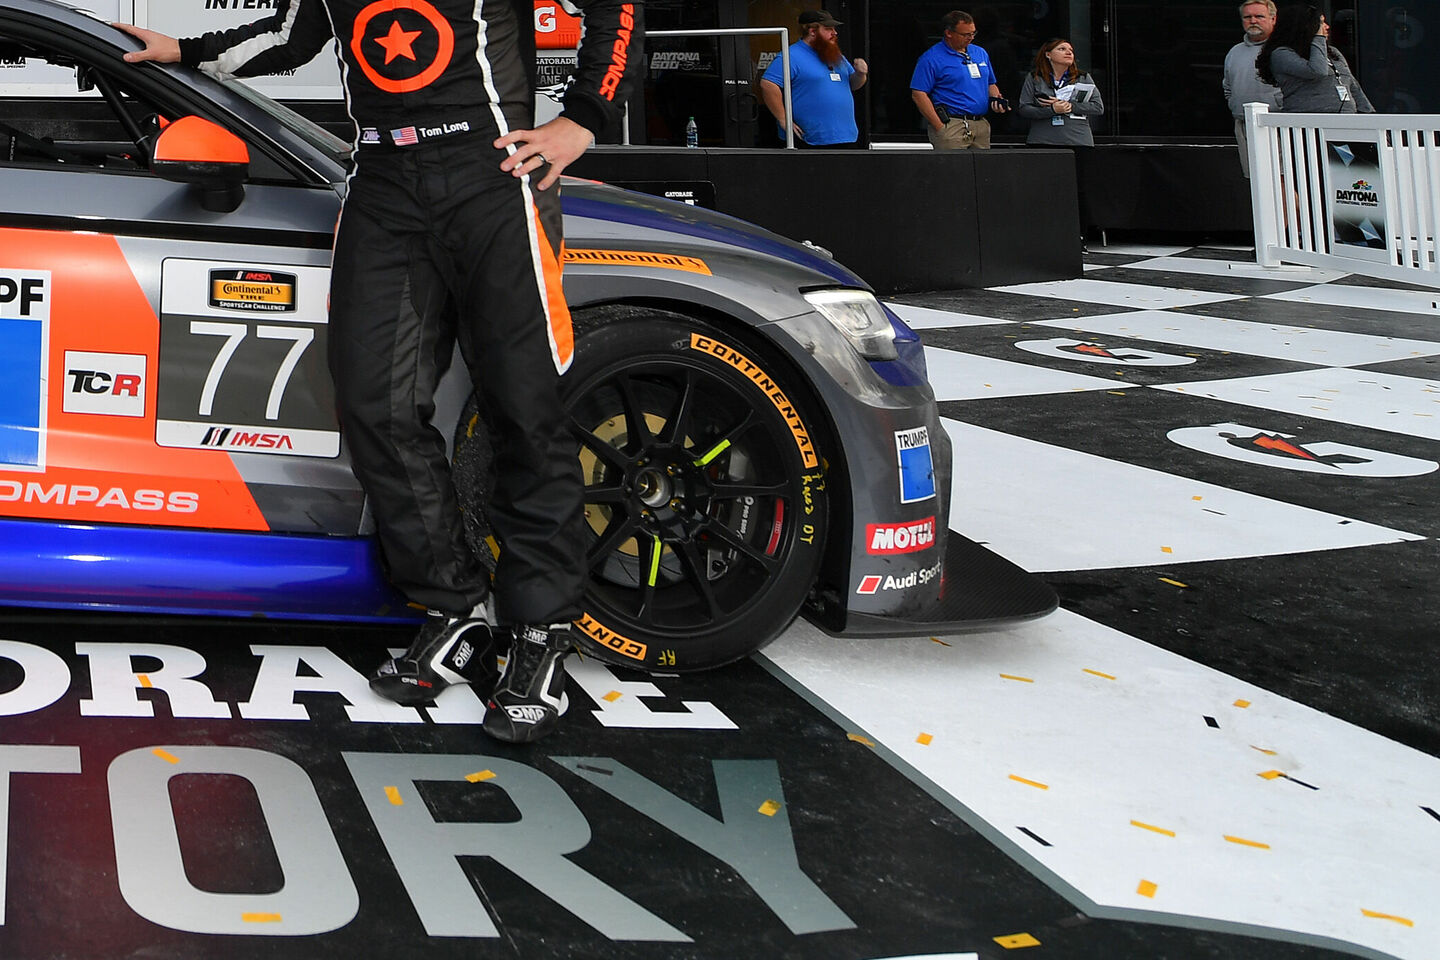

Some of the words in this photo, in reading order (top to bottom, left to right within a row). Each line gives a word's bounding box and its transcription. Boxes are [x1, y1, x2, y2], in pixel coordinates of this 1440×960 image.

[536, 66, 570, 76] ICTOR
[419, 127, 442, 138] Tom
[443, 121, 470, 133] Long
[1336, 190, 1378, 203] DAYTONA
[563, 252, 684, 267] ontinental
[245, 272, 272, 281] IMSA
[223, 283, 273, 294] Continental
[189, 320, 315, 421] 77
[68, 369, 141, 397] TCR
[695, 335, 816, 463] CONTINENTAL
[230, 432, 293, 450] IMSA
[897, 429, 928, 448] TRUMPF
[871, 522, 934, 550] MOTUL
[882, 571, 917, 591] Audi
[918, 560, 942, 585] Sport
[455, 641, 473, 668] OMP
[509, 706, 546, 721] OMP
